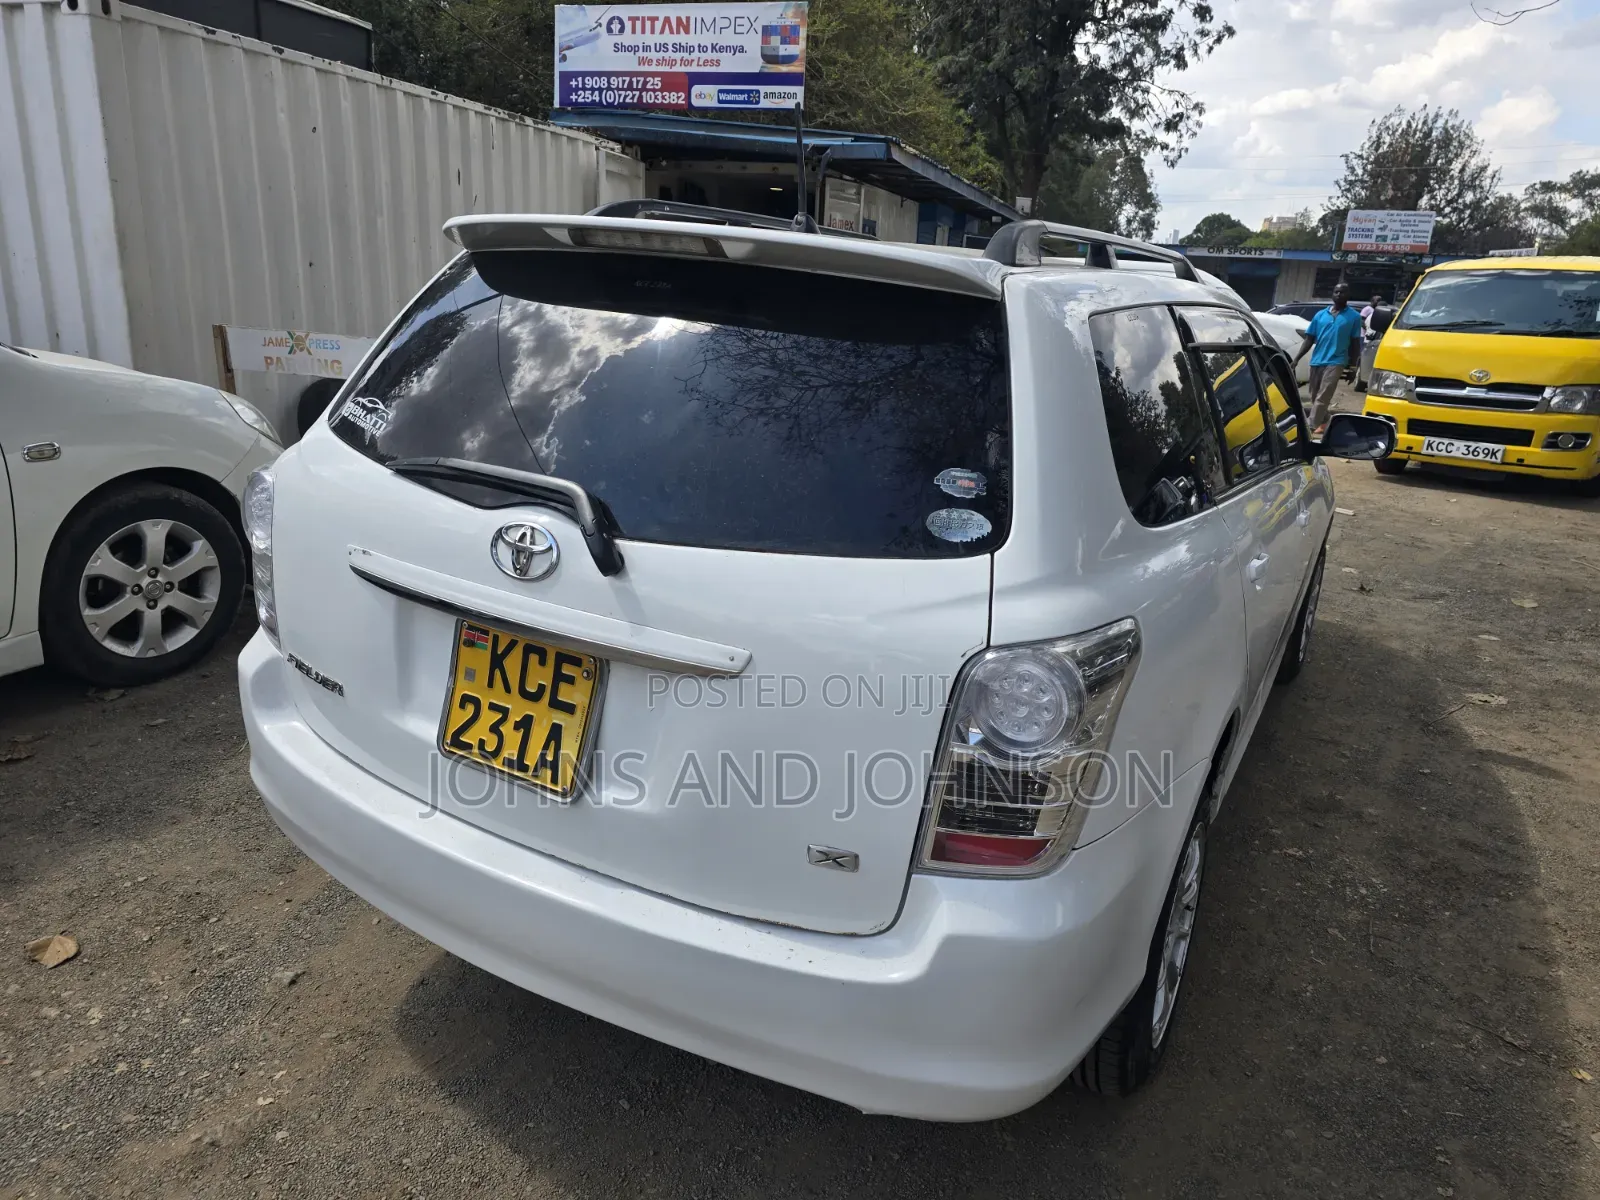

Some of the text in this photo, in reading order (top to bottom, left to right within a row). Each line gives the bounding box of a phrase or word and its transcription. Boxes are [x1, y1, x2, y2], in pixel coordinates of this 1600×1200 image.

[628, 15, 691, 35] TITAN
[613, 42, 747, 56] Shop in US Ship to Kenya.
[637, 56, 721, 68] We ship for Less
[570, 77, 662, 89] +1 908 917 17 25
[570, 90, 686, 106] +254 (0)727 103382
[694, 90, 716, 102] ebay
[718, 92, 748, 102] Walmart
[763, 91, 798, 103] amazon
[827, 213, 855, 231] Jamex
[1207, 246, 1265, 256] OM SPORTS
[1426, 438, 1502, 461] KCC 369K
[487, 633, 583, 716] KCE
[449, 692, 564, 785] 231A
